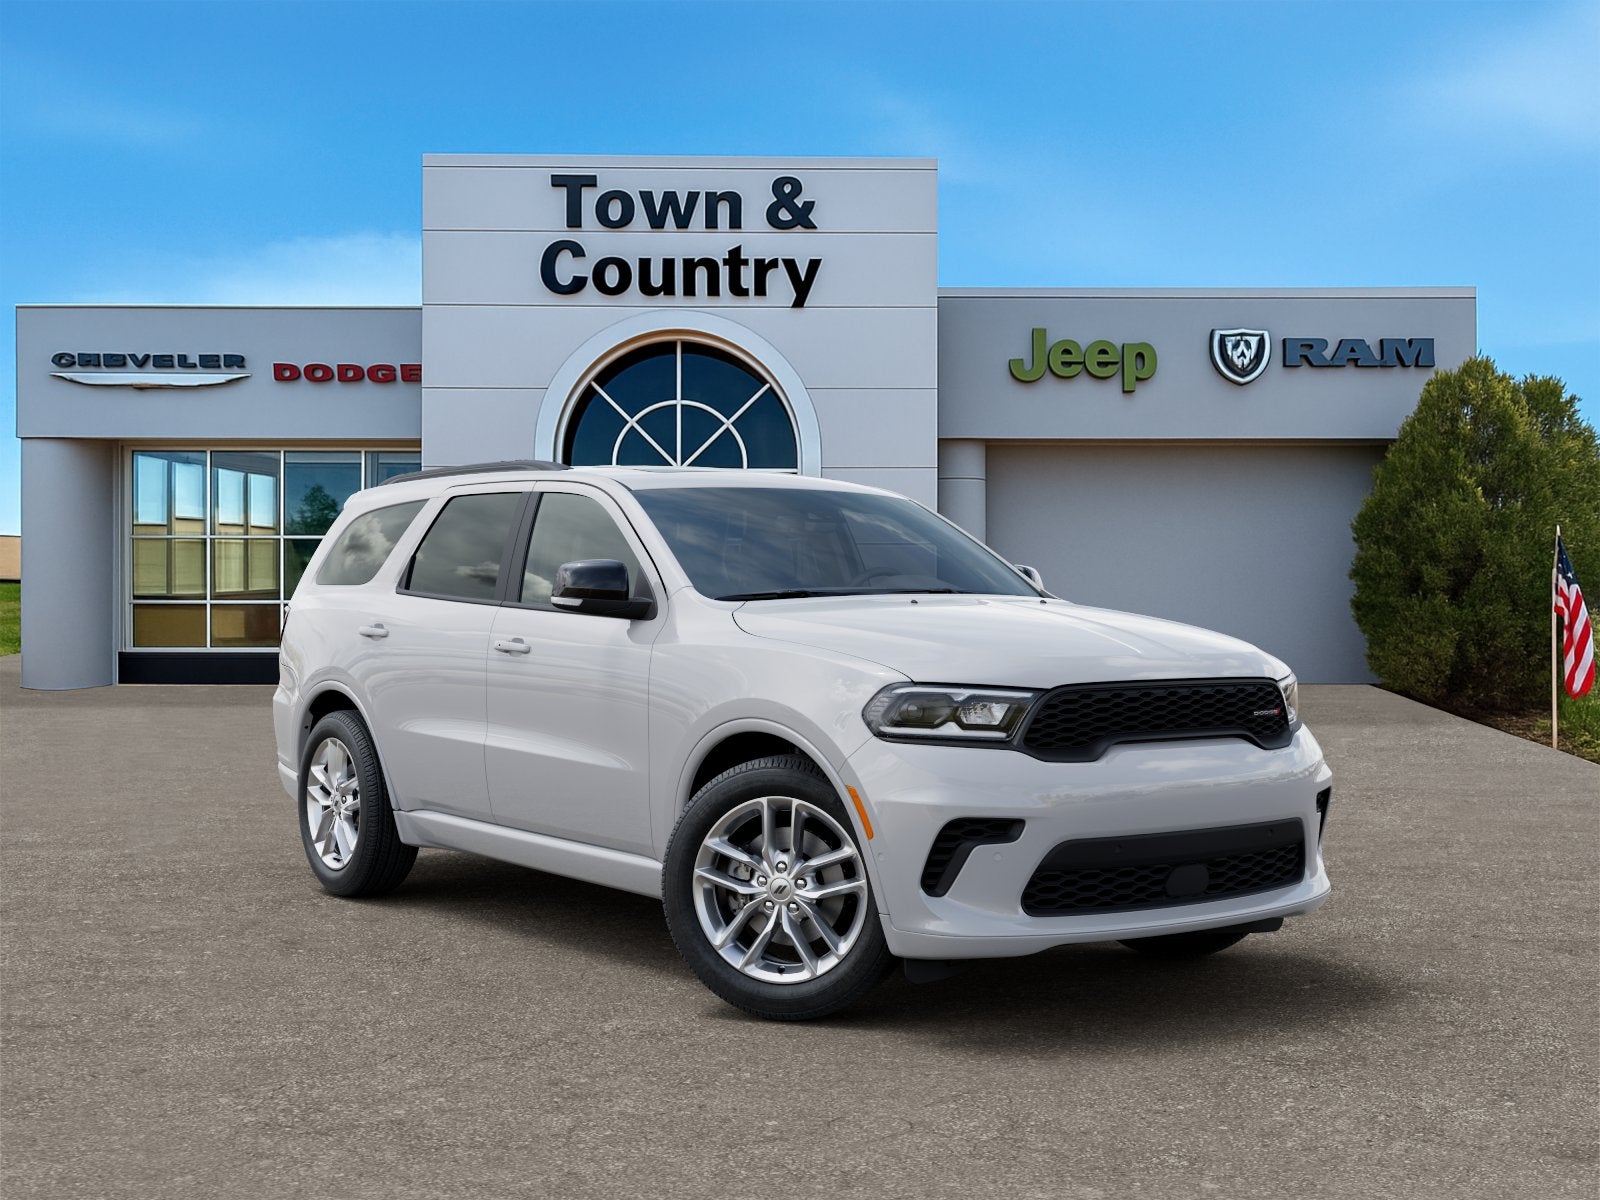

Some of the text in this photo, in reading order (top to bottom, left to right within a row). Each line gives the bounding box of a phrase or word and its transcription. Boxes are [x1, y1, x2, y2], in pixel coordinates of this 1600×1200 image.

[550, 174, 818, 230] Town &
[540, 239, 822, 308] Country
[272, 363, 421, 383] DODGE
[1008, 327, 1157, 392] Jeep
[1282, 337, 1435, 368] RAM
